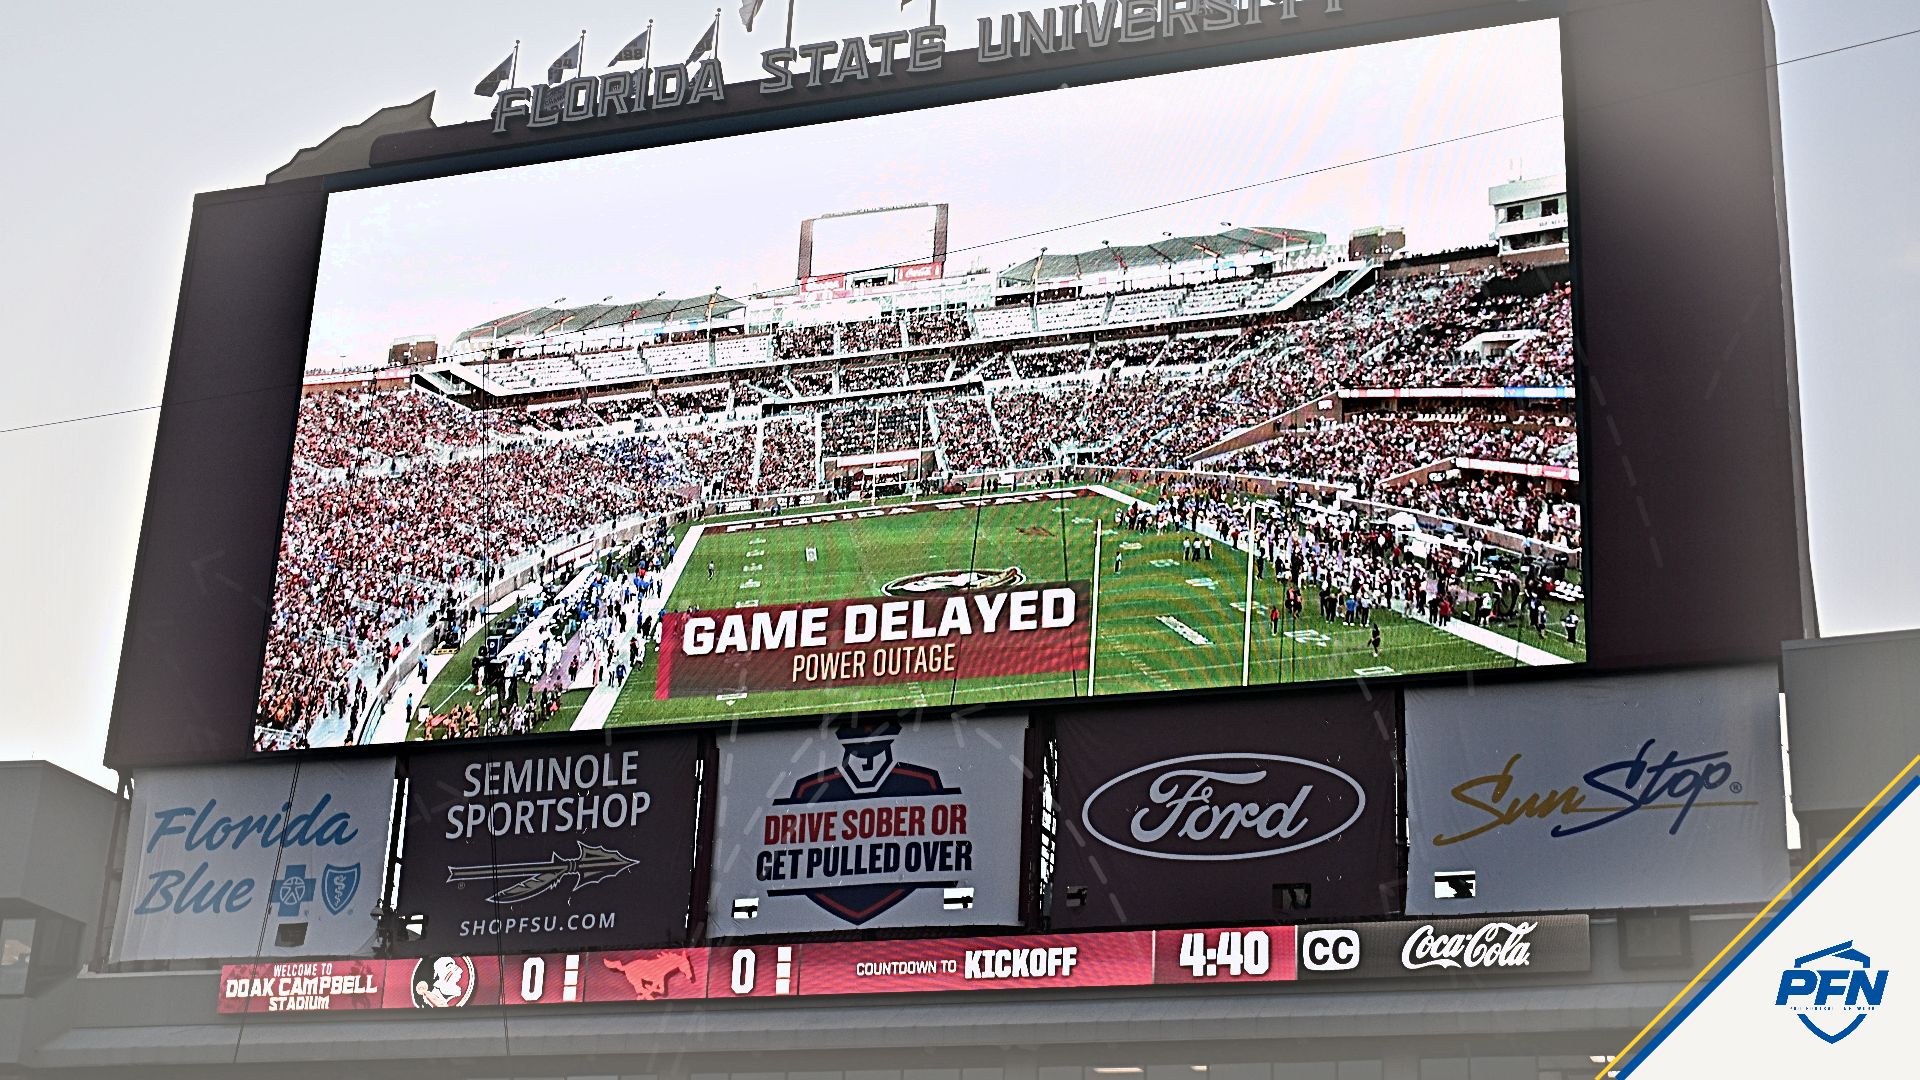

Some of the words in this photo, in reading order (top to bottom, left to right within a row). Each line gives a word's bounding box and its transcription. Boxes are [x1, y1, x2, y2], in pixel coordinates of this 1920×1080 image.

[492, 59, 724, 133] FLORIDA
[761, 25, 946, 94] STATE
[682, 608, 829, 656] GAME
[844, 587, 1076, 643] DELAYED
[792, 649, 866, 682] POWER
[873, 643, 955, 677] OUTAGE
[463, 750, 639, 797] SEMINOLE
[146, 793, 359, 853] Florida
[445, 791, 650, 839] SPORTSHOP
[764, 809, 838, 845] DRIVE
[841, 806, 926, 841] SOBER
[931, 804, 968, 837] OR
[1130, 769, 1314, 843] Ford
[756, 849, 803, 881] GET
[806, 843, 900, 878] PULLED
[905, 841, 972, 874] OVER
[133, 861, 255, 915] Blue
[460, 912, 616, 936] SHOPFSU.COM
[1401, 921, 1538, 970] Coca-Cola
[273, 963, 318, 978] WELCOME
[321, 962, 333, 976] TO
[730, 948, 756, 995] 0
[856, 961, 935, 976] COUNTDOWN
[940, 959, 957, 973] TO
[964, 947, 1078, 979] KICKOFF
[1179, 930, 1269, 977] 4:40
[1308, 936, 1354, 965] CC
[225, 977, 275, 998] DOAK
[278, 974, 378, 997] CAMPBELL
[520, 957, 545, 1001] 0
[268, 996, 330, 1011] STADIUM
